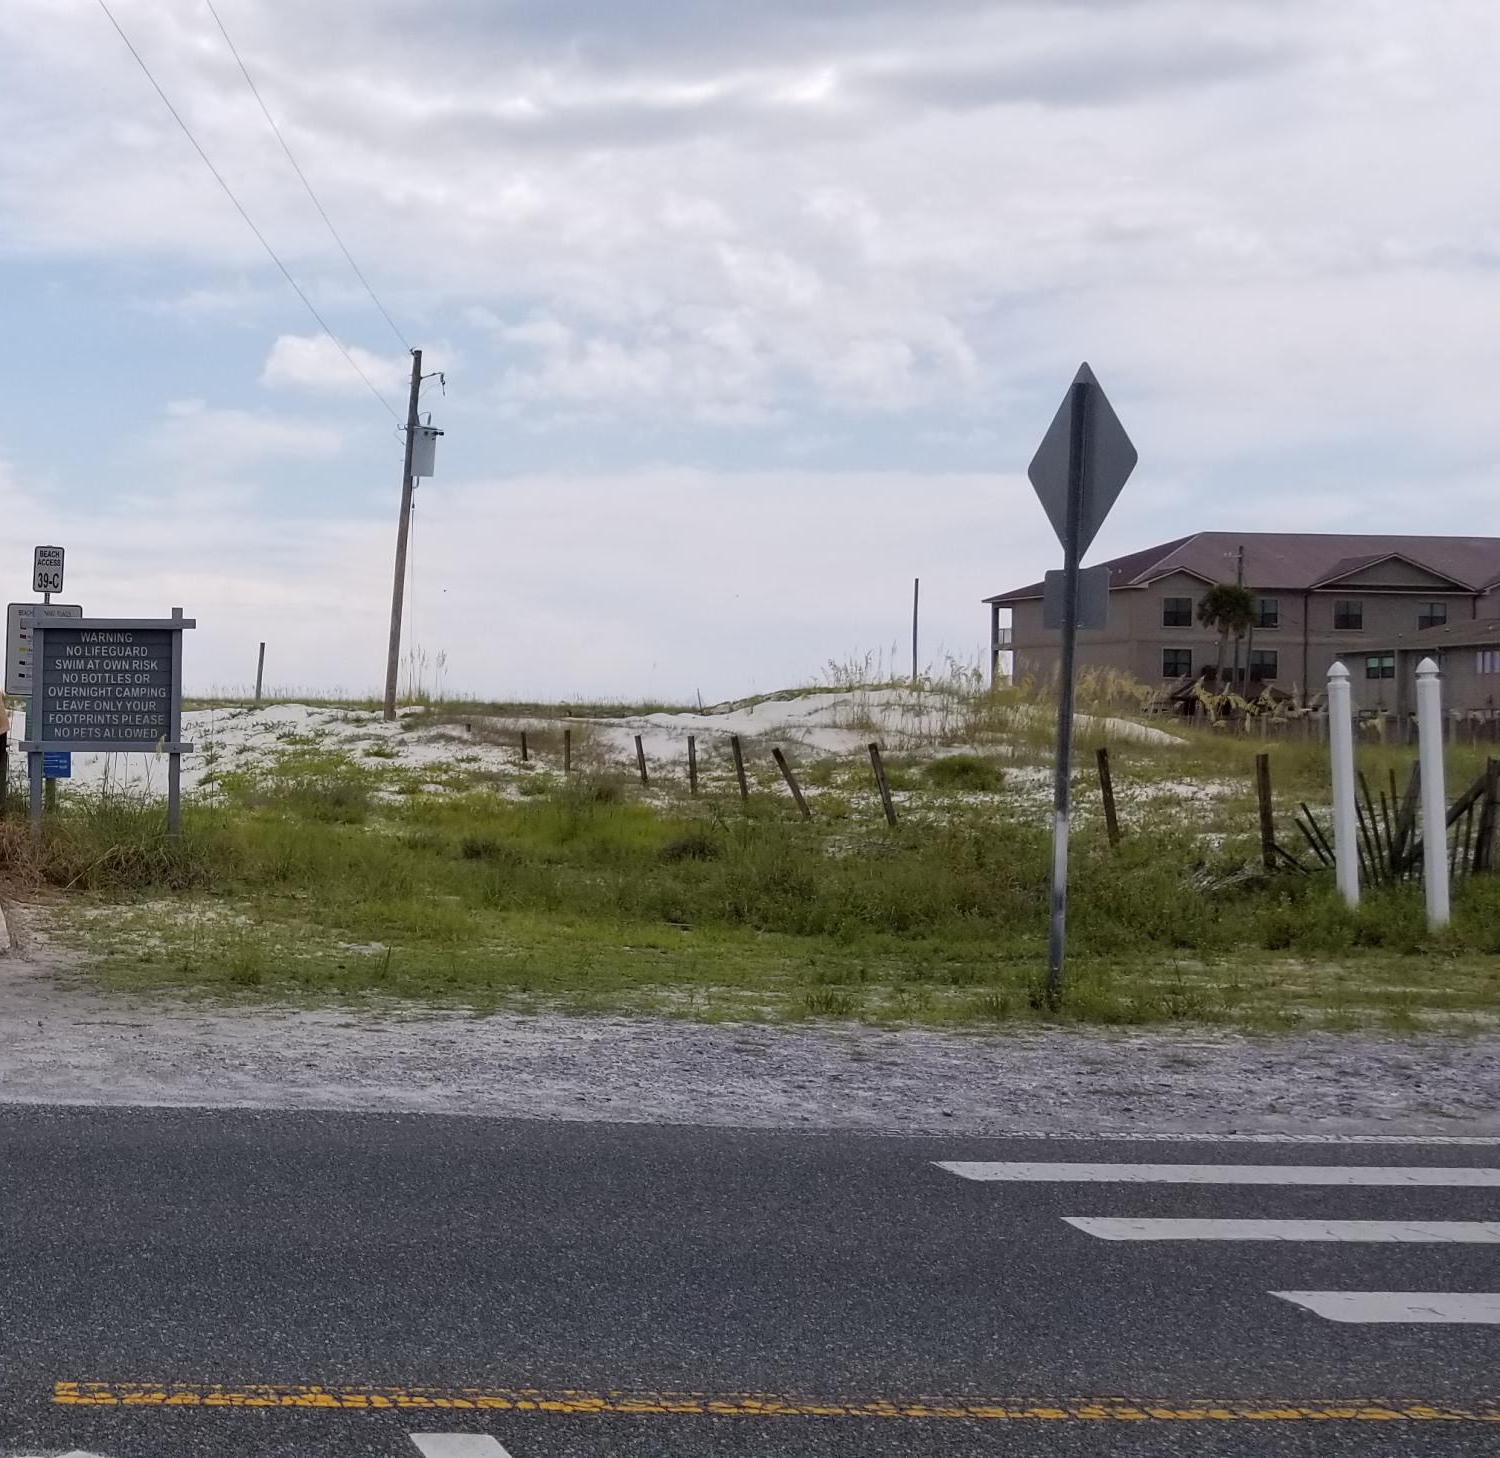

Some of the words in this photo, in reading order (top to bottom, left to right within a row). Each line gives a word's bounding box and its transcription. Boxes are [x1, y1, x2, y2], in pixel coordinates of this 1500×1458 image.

[39, 550, 60, 558] BEACH
[37, 559, 61, 567] ACCESS
[37, 573, 60, 589] 39-C
[81, 632, 133, 643] WARNING
[66, 646, 82, 656] NO
[85, 646, 148, 657] LIFEGUARD
[55, 660, 84, 670] SWIM
[87, 660, 100, 670] AT
[103, 660, 129, 670] OWN
[132, 660, 158, 671] RISK
[62, 673, 78, 683] NO
[81, 673, 132, 684] BOTTLES
[134, 674, 150, 684] OR
[48, 686, 112, 697] OVERNIGHT
[115, 687, 166, 698] CAMPING
[56, 700, 91, 711] LEAVE
[94, 700, 123, 711] ONLY
[126, 701, 156, 711] YOUR
[49, 713, 119, 725] FOOTPRINTS
[121, 714, 165, 725] PLEASE
[54, 727, 70, 738] NO
[73, 727, 101, 738] PETS
[103, 728, 158, 739] ALLOWED
